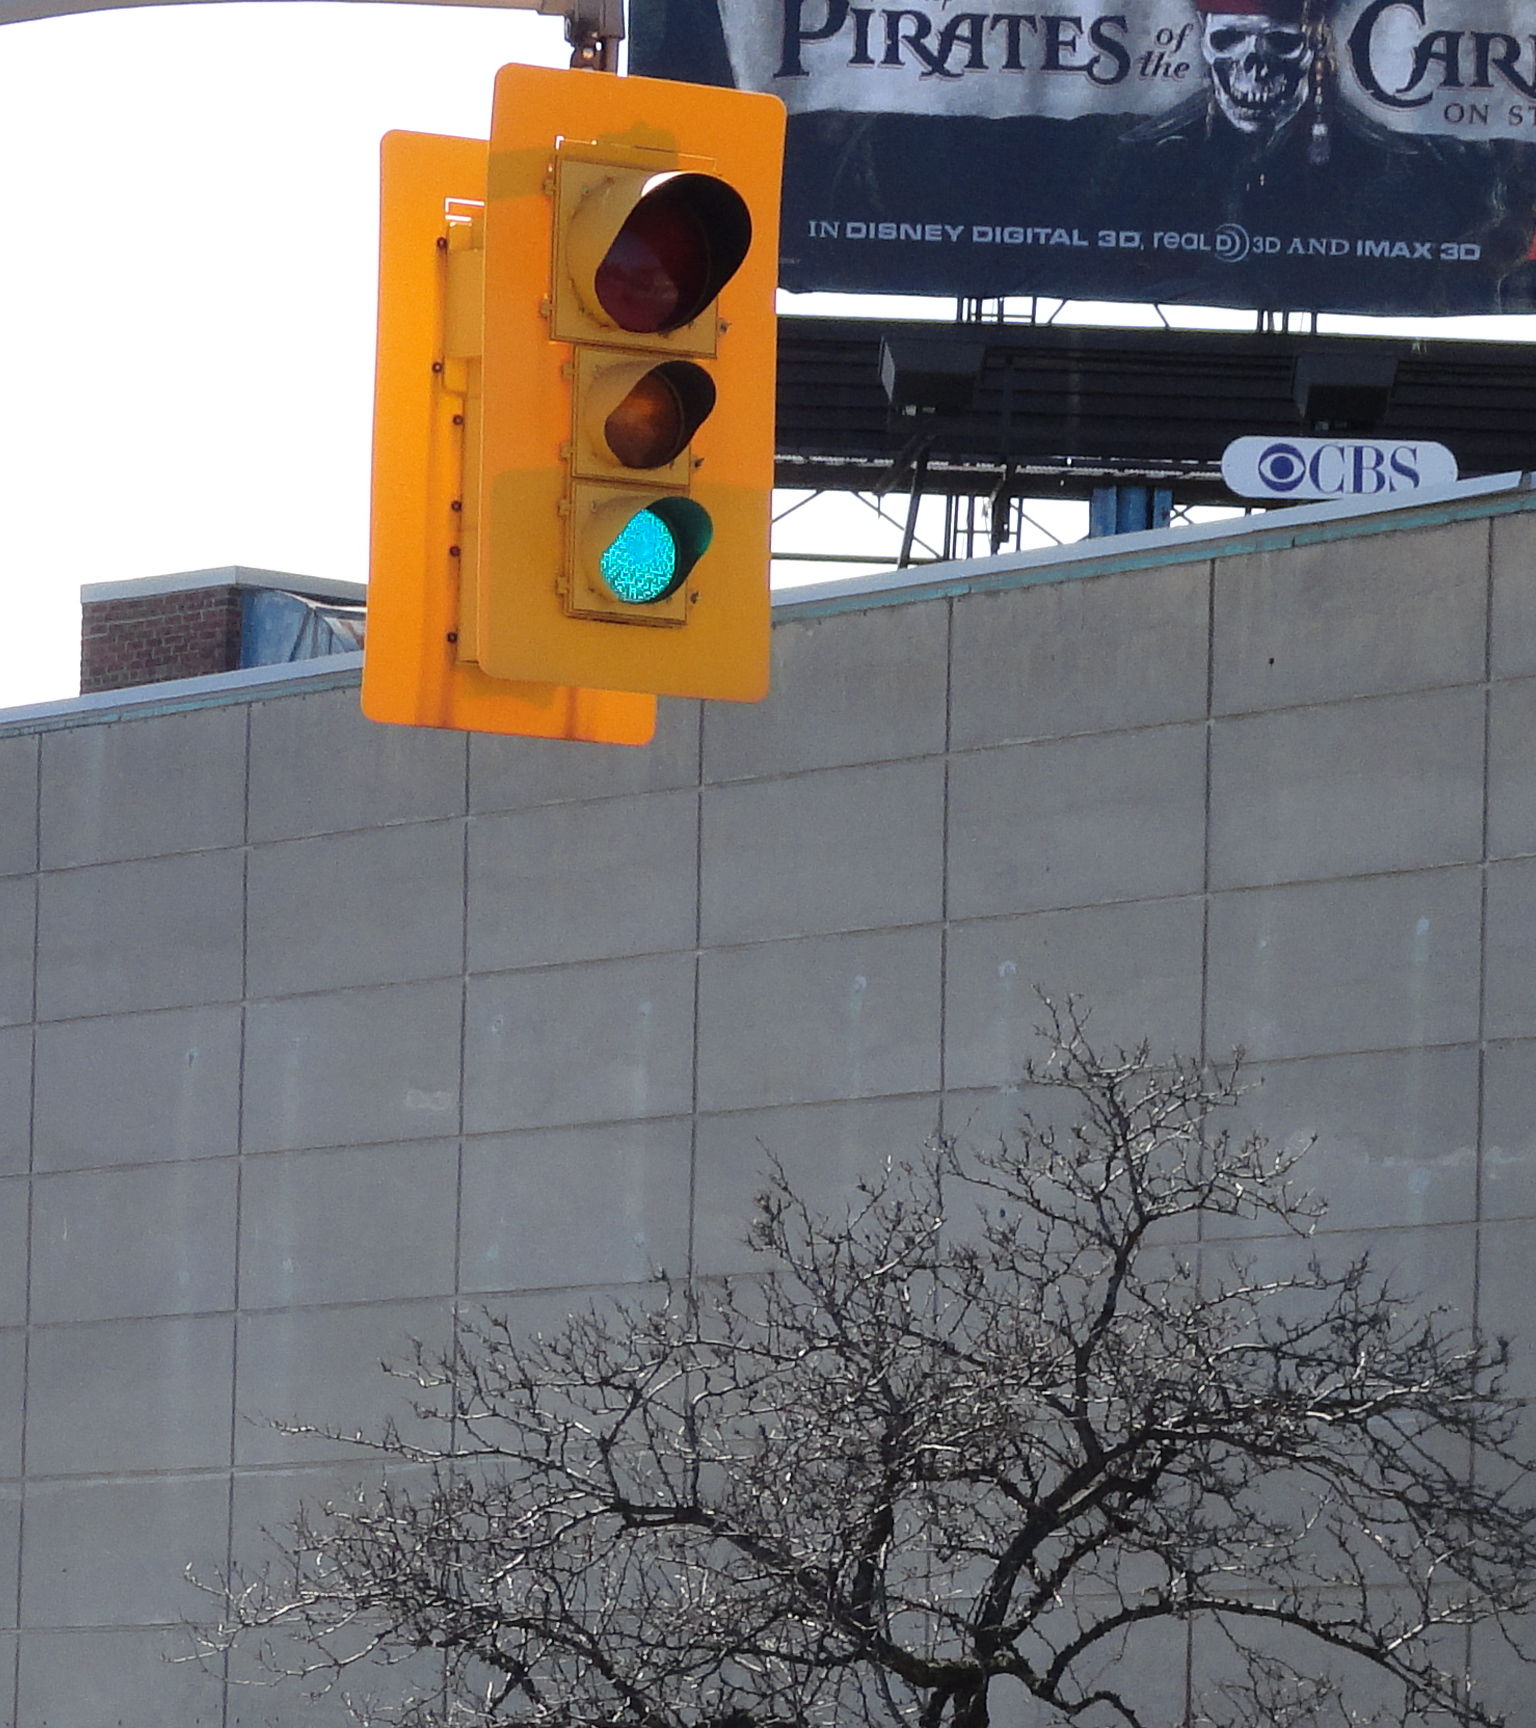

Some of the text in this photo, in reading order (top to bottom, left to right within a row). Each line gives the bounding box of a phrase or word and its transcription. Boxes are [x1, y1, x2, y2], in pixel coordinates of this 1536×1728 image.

[772, 0, 1132, 86] PIRATES
[1155, 22, 1194, 53] of
[1138, 49, 1191, 79] the
[1443, 102, 1491, 126] ON
[808, 220, 842, 239] IN
[845, 221, 965, 243] DISNEY
[972, 225, 1090, 247] DIGITAL
[1252, 236, 1282, 254] 3D
[1287, 238, 1350, 258] AND
[1357, 239, 1433, 261] IMAX
[1440, 242, 1481, 262] 3D
[1308, 444, 1421, 495] CBS
